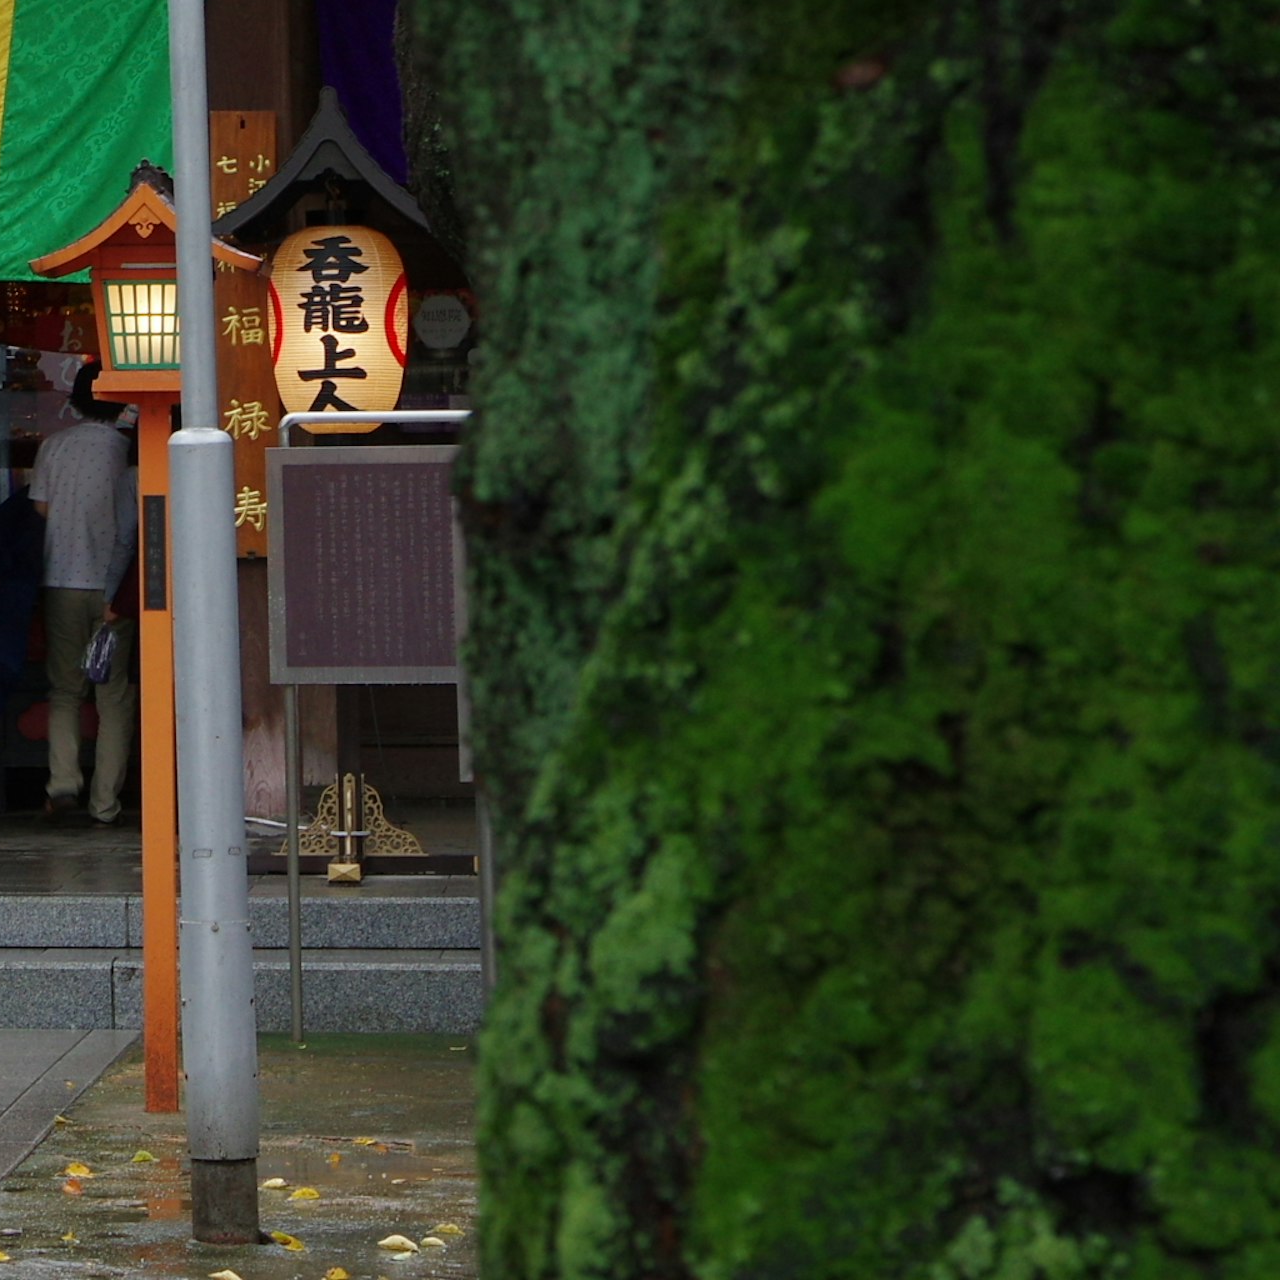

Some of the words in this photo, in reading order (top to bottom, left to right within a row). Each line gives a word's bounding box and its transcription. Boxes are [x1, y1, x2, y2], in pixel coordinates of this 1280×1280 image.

[221, 305, 272, 532] 福禄寿
[297, 235, 370, 412] 呑龍上人
